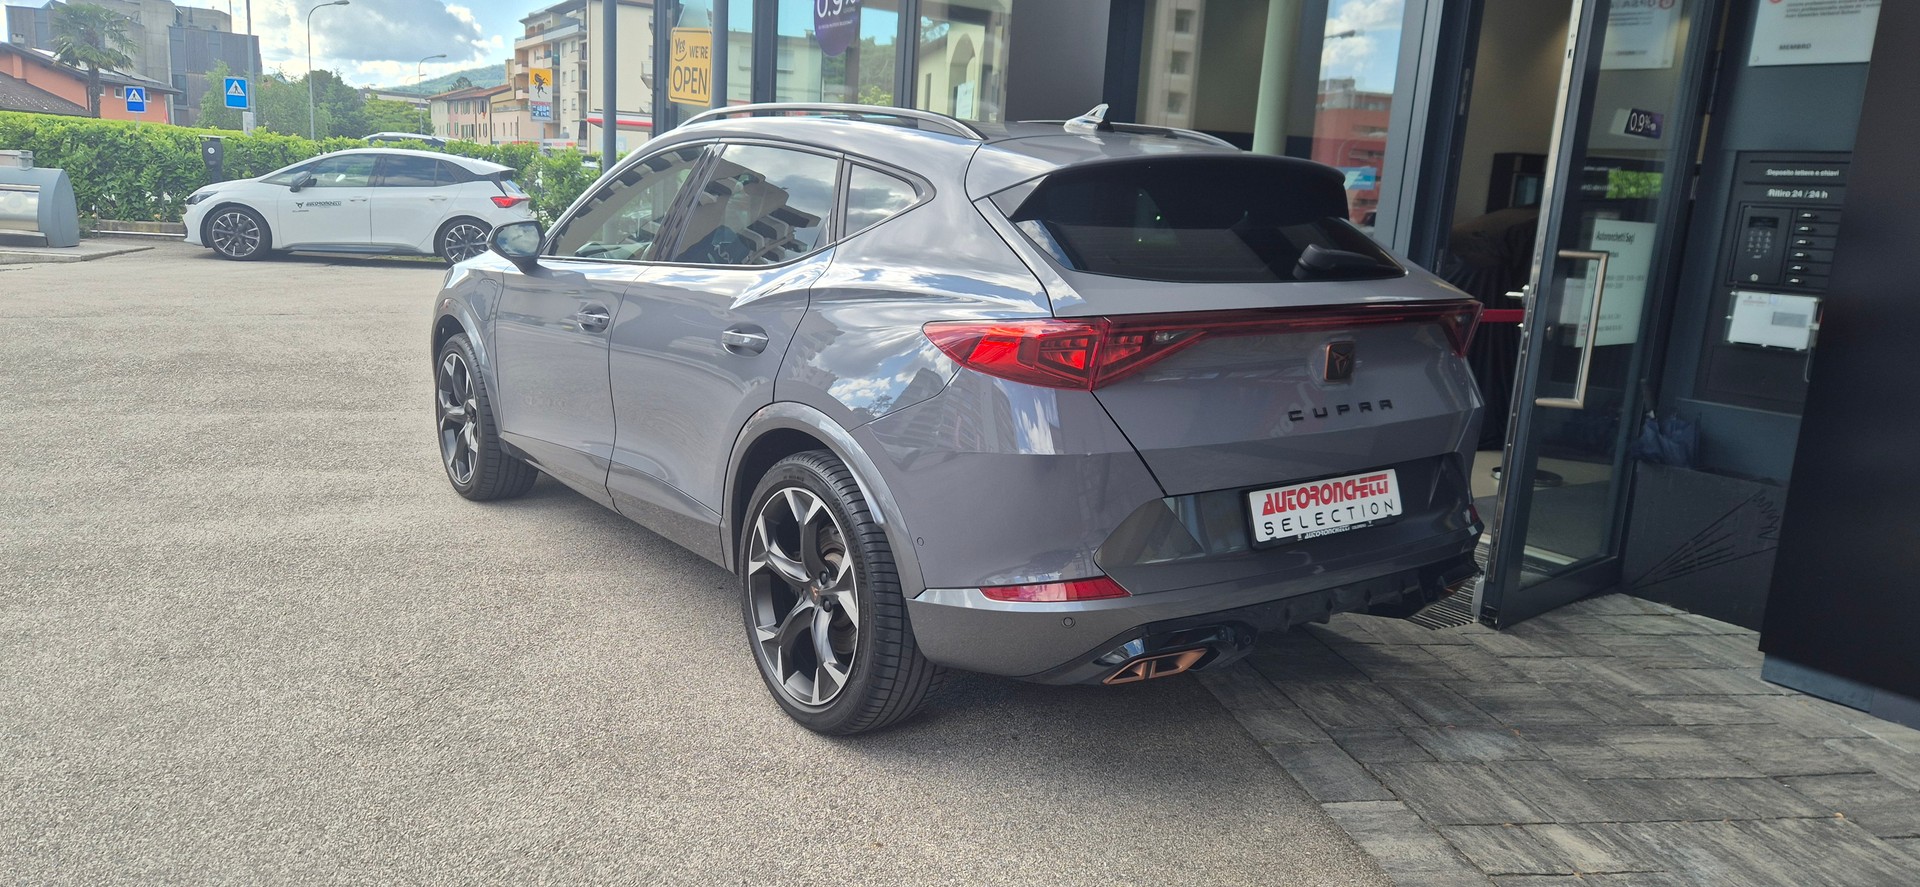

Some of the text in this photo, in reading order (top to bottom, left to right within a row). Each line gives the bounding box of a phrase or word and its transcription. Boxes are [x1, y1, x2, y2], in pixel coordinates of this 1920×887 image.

[817, 0, 856, 17] 0.9
[689, 45, 709, 59] WE'RE
[673, 66, 707, 95] OPEN
[1768, 188, 1791, 198] Ritiro
[1791, 189, 1803, 198] 24
[1808, 190, 1820, 199] 24
[1821, 190, 1829, 199] h
[1288, 399, 1393, 422] CUPRA
[1262, 473, 1389, 516] AUTORONCHETTI
[1264, 499, 1394, 536] SELECTION
